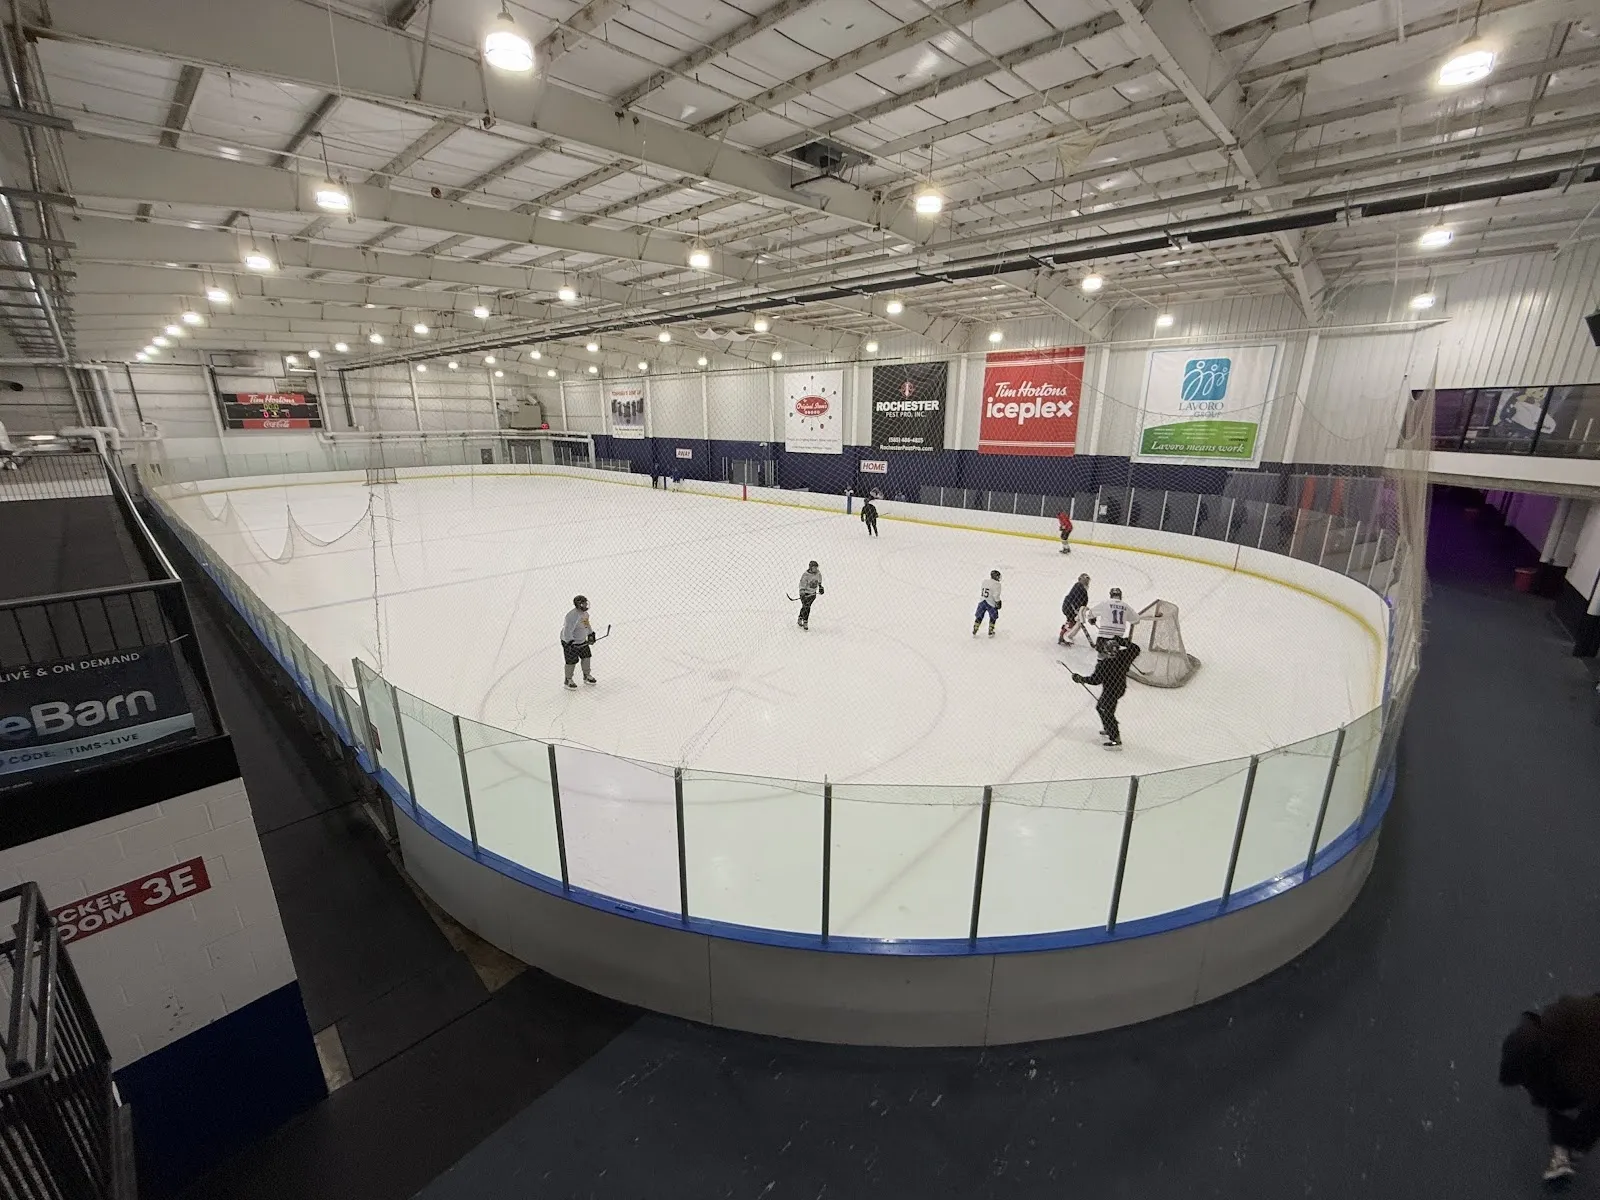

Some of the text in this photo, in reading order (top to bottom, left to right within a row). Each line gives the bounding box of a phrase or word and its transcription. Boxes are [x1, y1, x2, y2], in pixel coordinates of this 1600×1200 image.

[995, 380, 1067, 398] Tim Hortons
[248, 393, 295, 404] Tim Hortons
[876, 400, 940, 412] ROCHESTER
[1178, 401, 1225, 411] LAVORO
[986, 396, 1074, 426] iceplex
[1151, 441, 1245, 453] Lavoro means work
[862, 461, 886, 472] HOME
[981, 587, 990, 599] 15
[1111, 609, 1125, 625] 11
[0, 652, 141, 684] LIVE & ON DEMAND
[67, 732, 140, 755] TIMS-LIVE
[50, 865, 198, 928] CKER 3E
[57, 900, 134, 942] OOM
